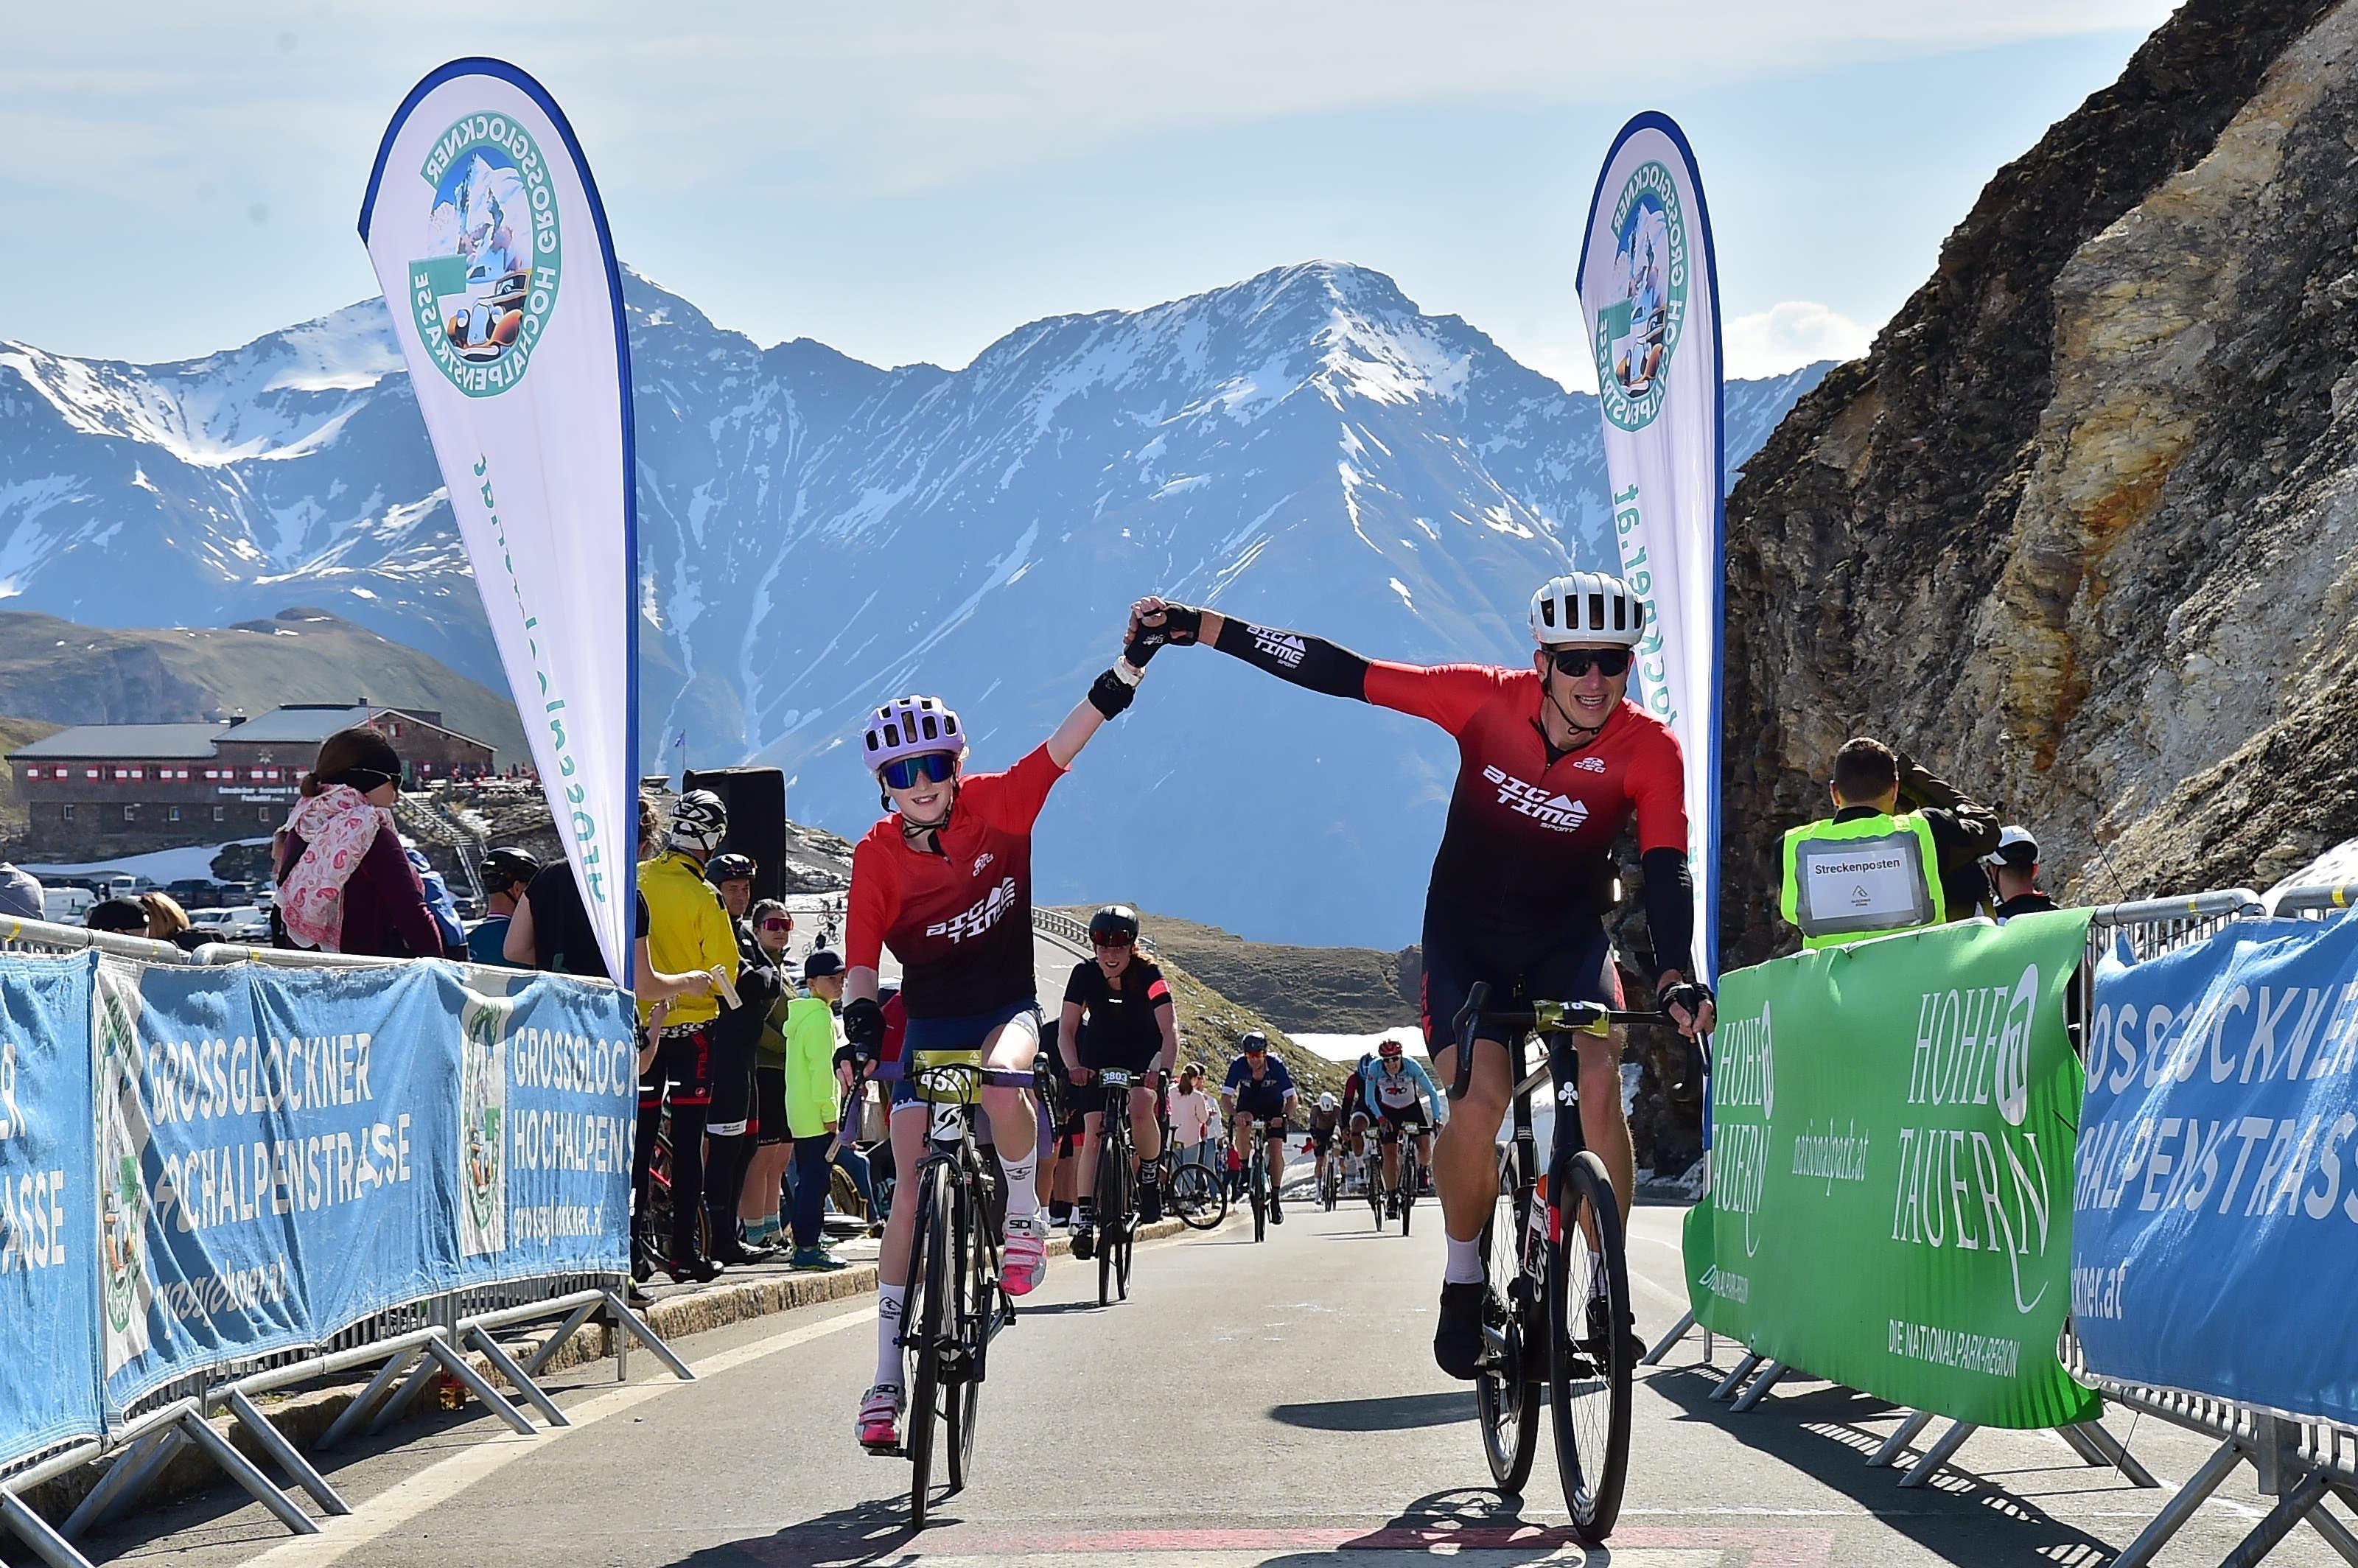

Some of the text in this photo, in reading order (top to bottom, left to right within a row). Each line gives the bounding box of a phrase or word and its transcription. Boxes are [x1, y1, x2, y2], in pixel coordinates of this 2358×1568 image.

[1246, 625, 1286, 643] BIG
[1254, 637, 1305, 665] TIME
[1482, 764, 1551, 803] BIG
[1497, 788, 1588, 827] TIME
[1539, 822, 1577, 833] SPORT
[1815, 858, 1901, 875] Streckenposten
[1715, 1016, 1762, 1107] HOHE
[1907, 984, 2010, 1106] HOHE
[1103, 1072, 1127, 1082] 3803
[1791, 1117, 1869, 1197] nationalpark.at
[0, 1170, 66, 1273] ASSE
[1892, 1126, 2049, 1315] TAUERN
[1889, 1318, 1903, 1356] DIE
